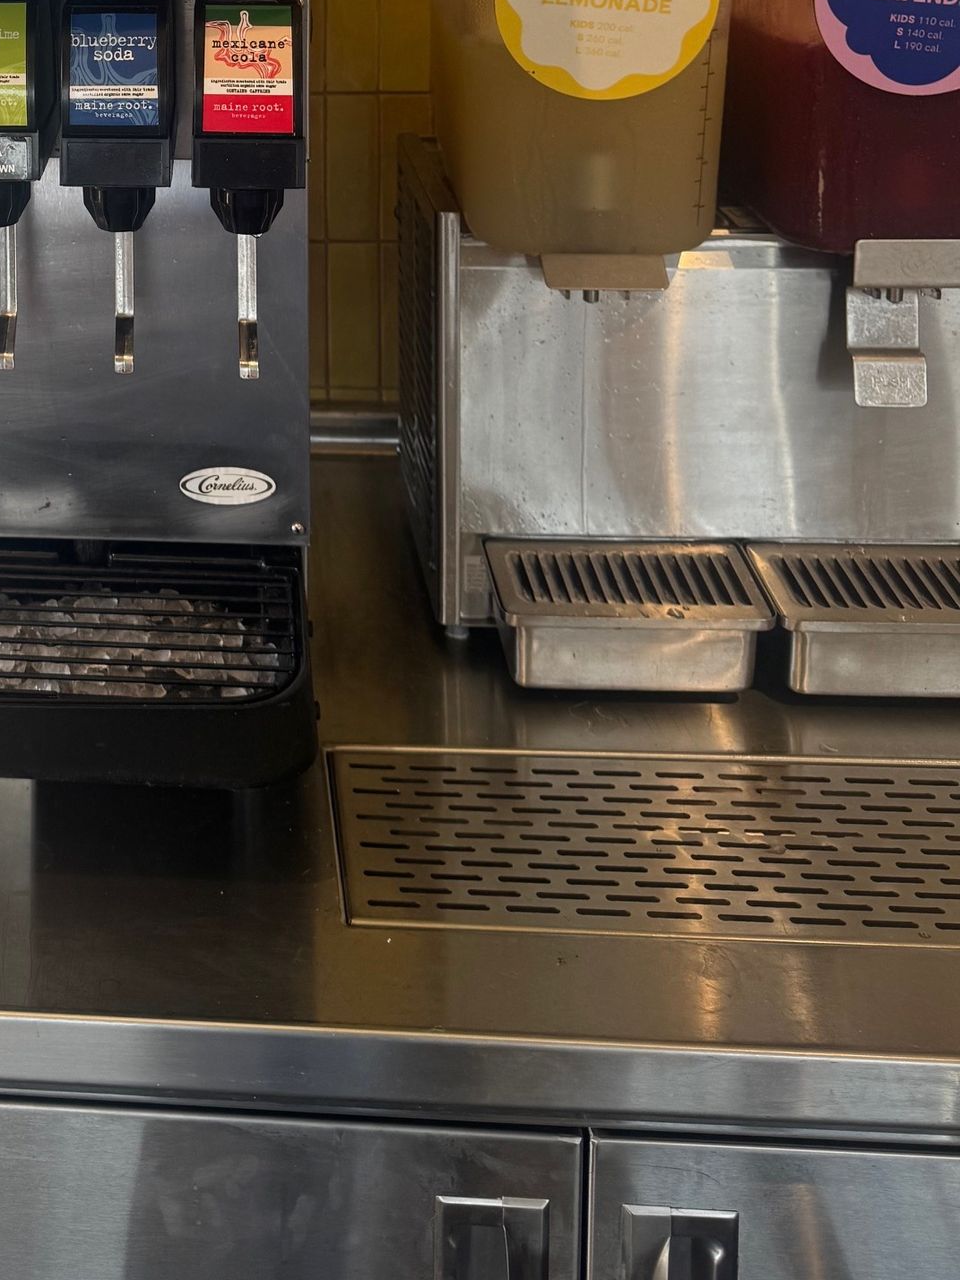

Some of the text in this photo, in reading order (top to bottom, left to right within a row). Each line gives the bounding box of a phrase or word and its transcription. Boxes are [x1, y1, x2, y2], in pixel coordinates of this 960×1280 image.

[570, 20, 594, 29] KIDS
[890, 13, 957, 28] KIDS 110 cal.
[896, 27, 904, 36] S
[907, 29, 925, 39] 140
[70, 33, 157, 50] blueberry
[212, 39, 285, 49] mexicane
[894, 40, 901, 49] L
[905, 41, 923, 51] 190
[93, 48, 134, 61] soda
[231, 52, 267, 63] cola
[75, 100, 152, 110] maine root.
[213, 102, 284, 112] maine root.
